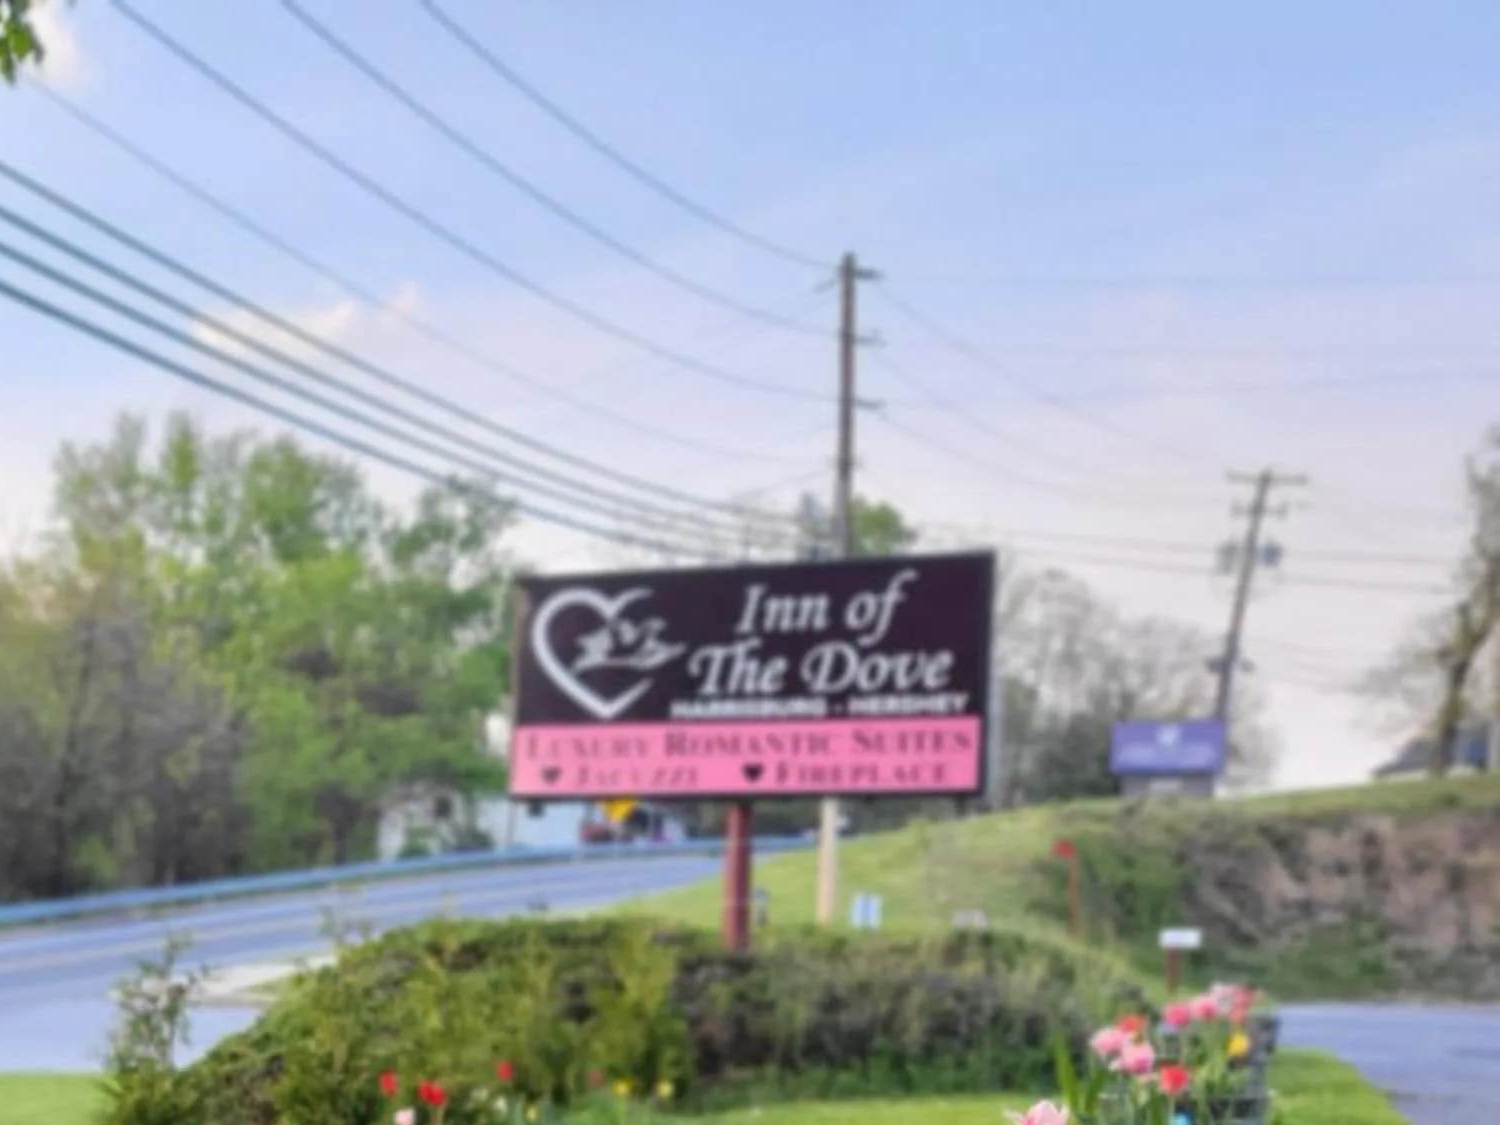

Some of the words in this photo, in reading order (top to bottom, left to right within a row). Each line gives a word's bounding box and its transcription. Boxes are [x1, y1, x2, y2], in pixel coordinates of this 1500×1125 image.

[735, 583, 830, 633] Inn
[844, 568, 919, 647] of
[687, 637, 788, 694] The
[800, 640, 954, 693] Dove
